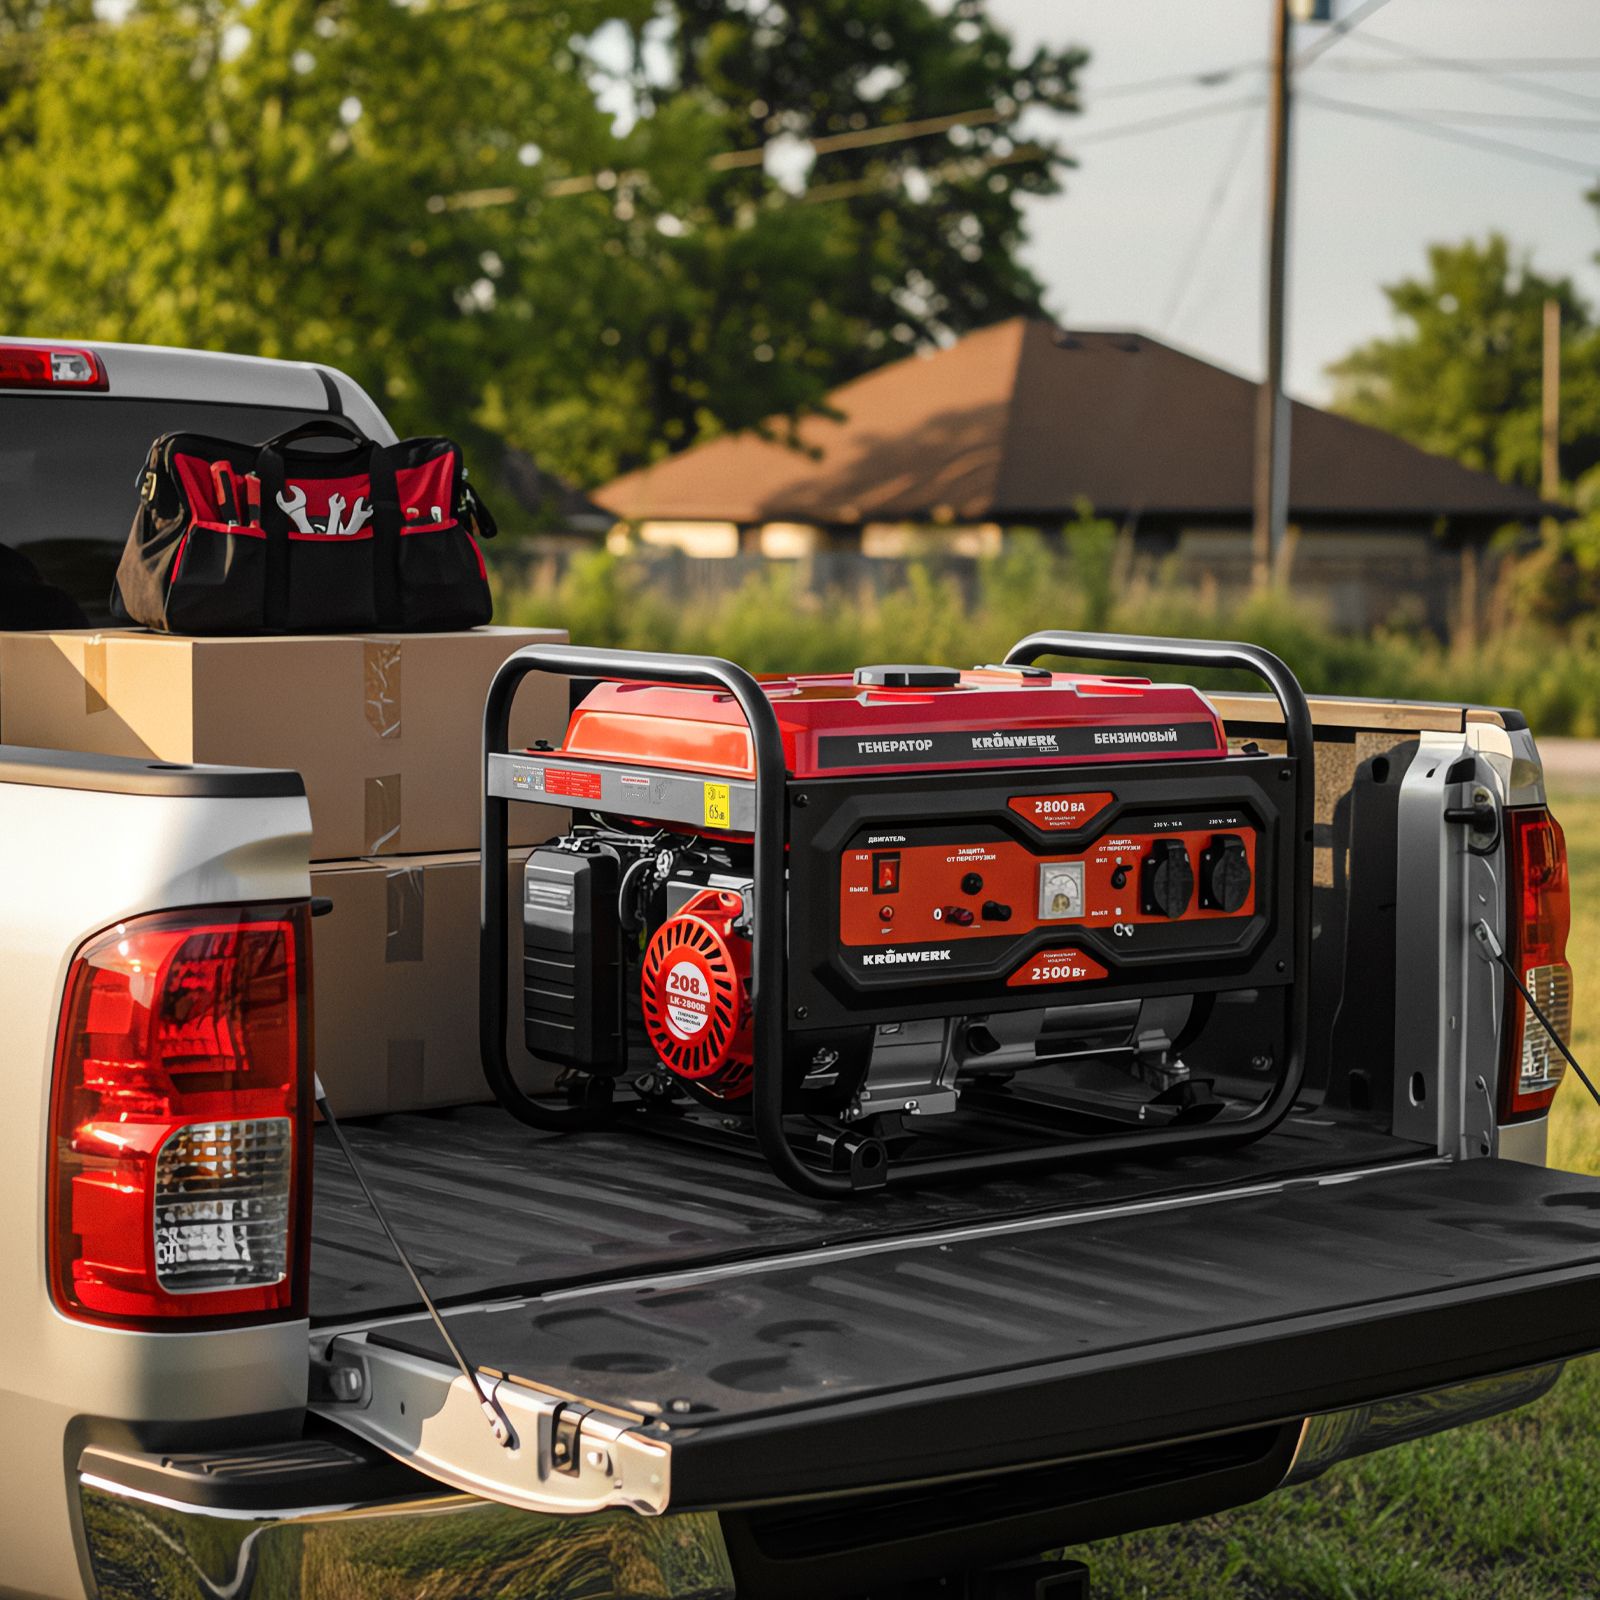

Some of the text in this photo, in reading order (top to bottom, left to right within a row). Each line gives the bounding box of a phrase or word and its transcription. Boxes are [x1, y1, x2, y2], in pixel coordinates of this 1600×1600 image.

[1094, 728, 1178, 745] БЕНЗИНОВЫЙ
[857, 739, 933, 754] ГЕНЕРАТОР
[1035, 800, 1086, 813] 2800 ВА
[868, 836, 906, 844] ДВИГАТЕЛЬ
[956, 854, 996, 862] ПЕРЕГРУЗКИ
[933, 908, 942, 921] 0
[1031, 966, 1087, 980] 2500 Вт
[670, 972, 700, 995] 208
[669, 995, 706, 1013] LK-2800R
